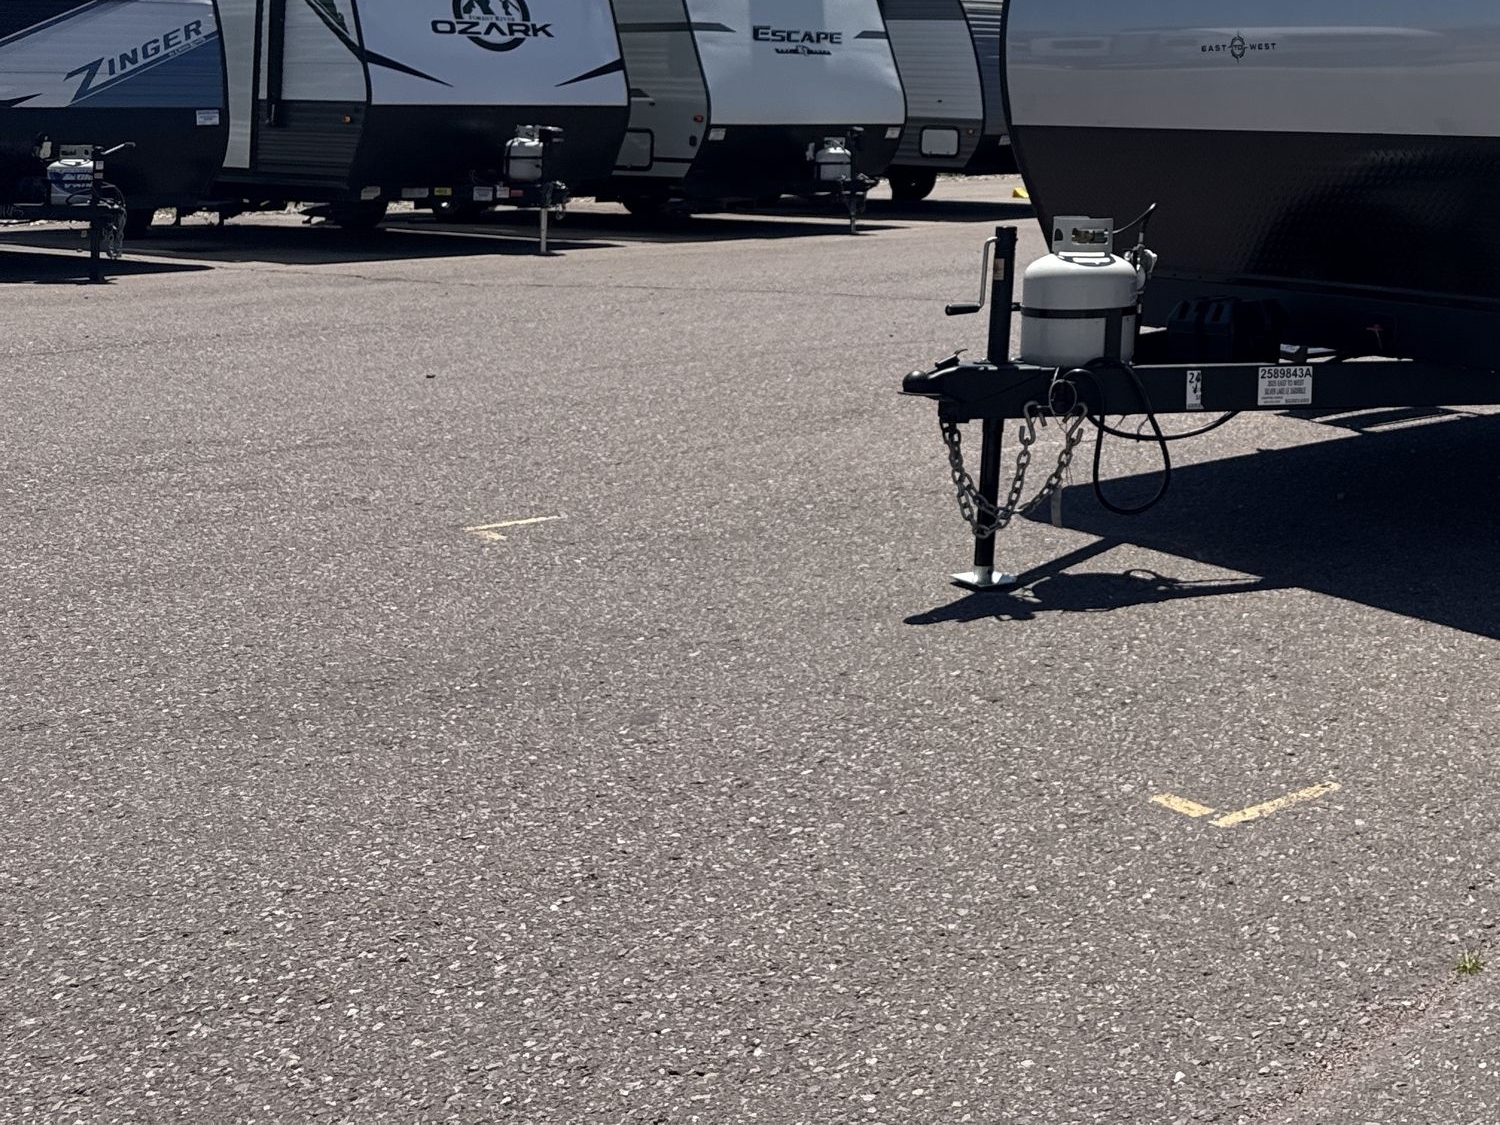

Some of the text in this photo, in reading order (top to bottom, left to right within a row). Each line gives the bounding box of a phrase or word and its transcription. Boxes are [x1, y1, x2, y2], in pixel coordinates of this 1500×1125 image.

[431, 19, 555, 38] OZARK
[752, 25, 842, 45] ESCAPE
[1201, 44, 1227, 53] EAST
[1249, 42, 1277, 51] WEST
[63, 19, 203, 103] ZINGER
[1260, 367, 1312, 379] 2589843A
